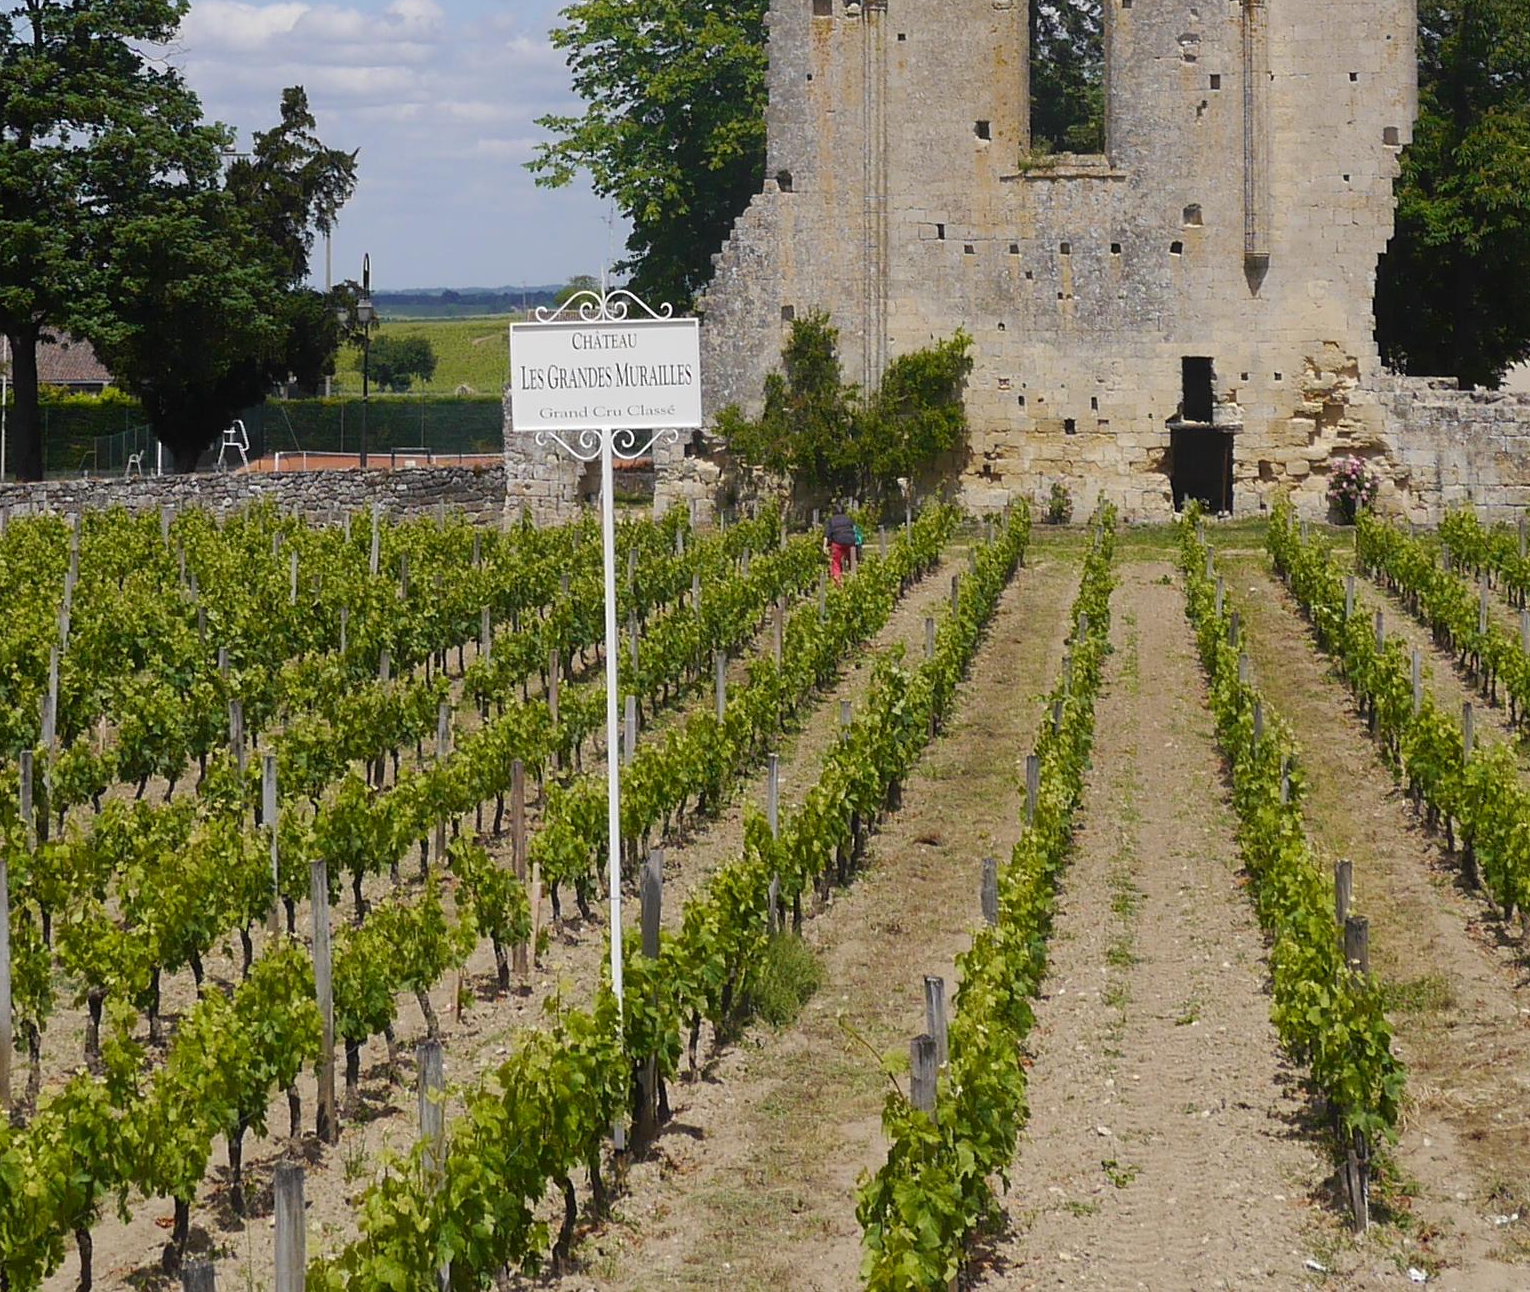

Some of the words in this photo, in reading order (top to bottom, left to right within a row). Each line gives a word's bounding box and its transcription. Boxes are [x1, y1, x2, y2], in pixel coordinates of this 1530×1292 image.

[571, 330, 638, 350] CHÂTEAU
[520, 365, 545, 391] LES
[547, 364, 613, 389] GRANDES
[615, 362, 693, 388] MURAILLES
[539, 406, 589, 420] Grand
[593, 406, 622, 418] Cru
[627, 404, 676, 417] Classé
